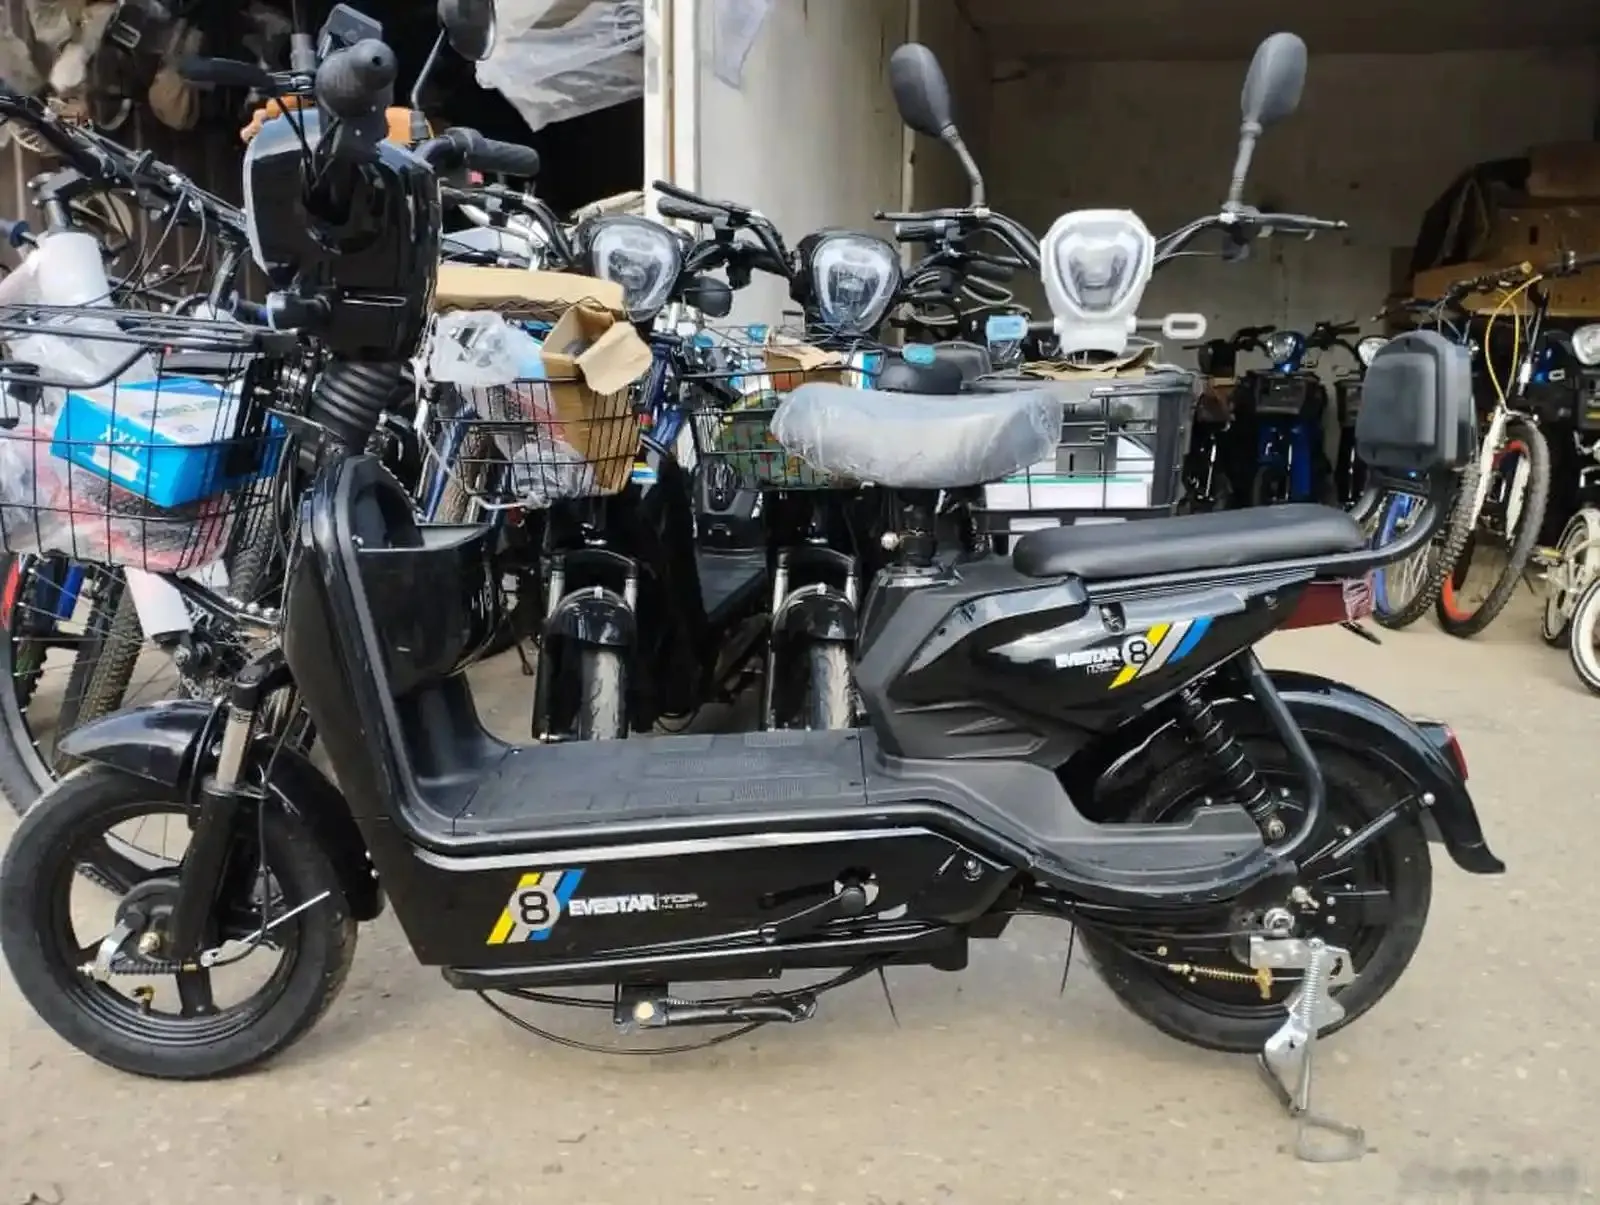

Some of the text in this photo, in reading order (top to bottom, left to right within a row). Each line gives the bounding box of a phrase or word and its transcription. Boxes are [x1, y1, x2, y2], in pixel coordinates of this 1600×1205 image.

[1129, 640, 1149, 664] 8
[518, 890, 657, 925] 8 EVESTAR
